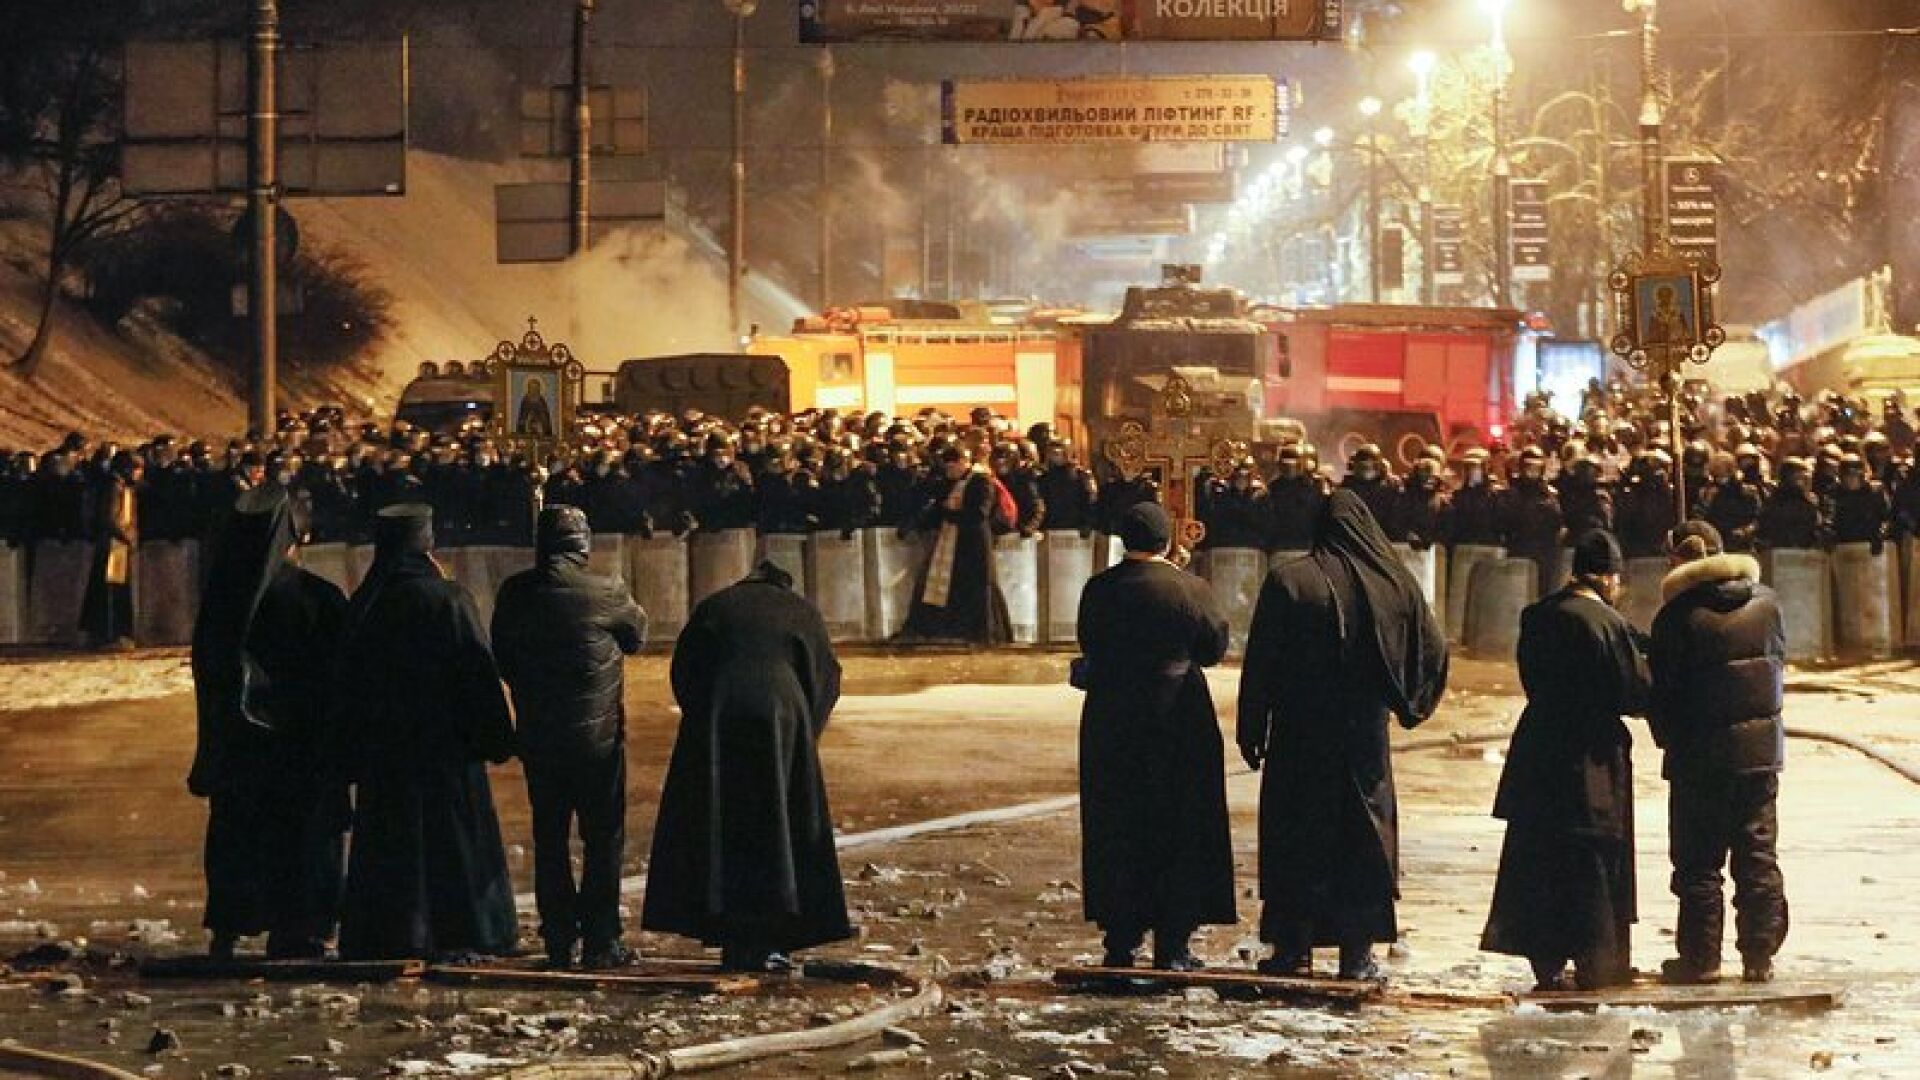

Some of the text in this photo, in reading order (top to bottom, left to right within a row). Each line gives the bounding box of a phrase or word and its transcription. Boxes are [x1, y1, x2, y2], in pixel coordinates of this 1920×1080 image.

[1156, 0, 1288, 22] КОЛЕКЦІЯ
[1144, 106, 1226, 121] ЛІФТИНГ
[1233, 106, 1254, 120] RF
